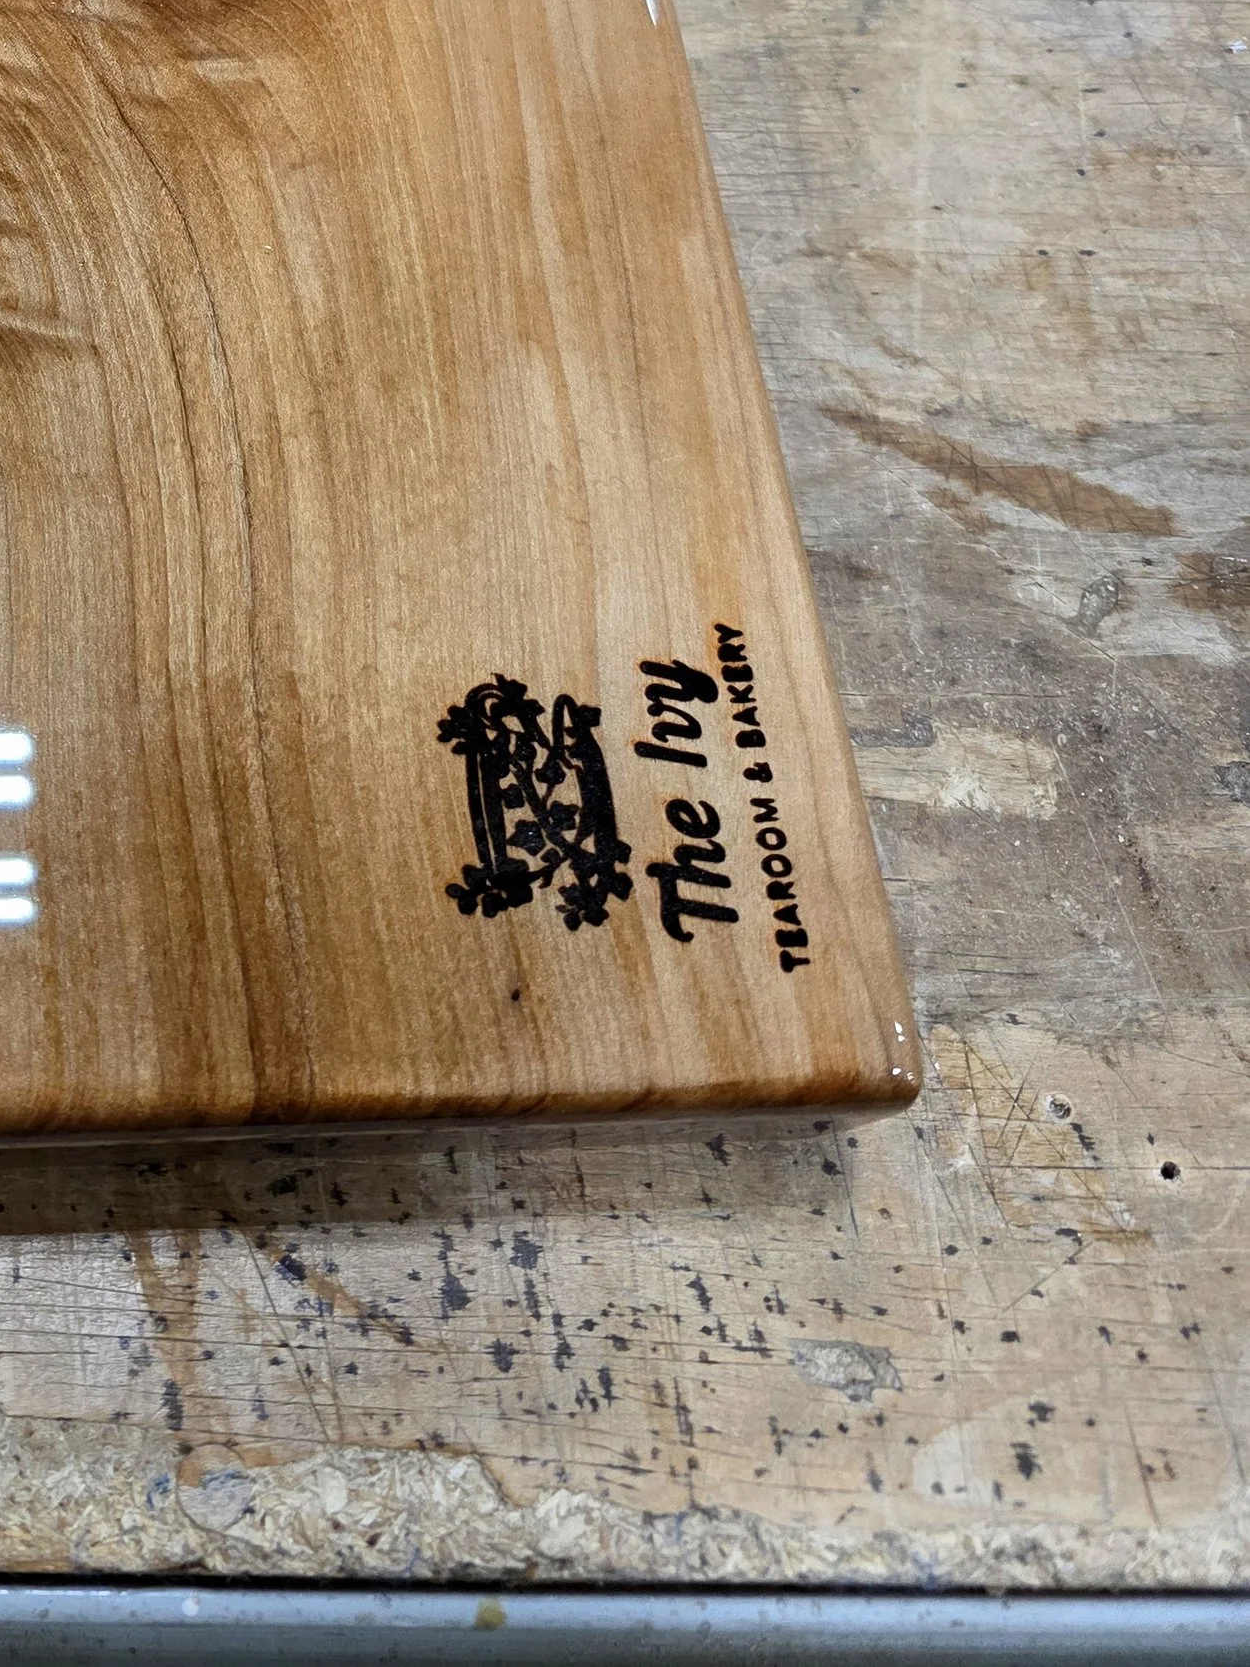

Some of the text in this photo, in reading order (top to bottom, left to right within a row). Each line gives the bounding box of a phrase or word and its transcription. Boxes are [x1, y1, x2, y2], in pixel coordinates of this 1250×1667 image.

[634, 659, 739, 943] The Ivy
[714, 623, 811, 973] TEAROOM & BAKERY
